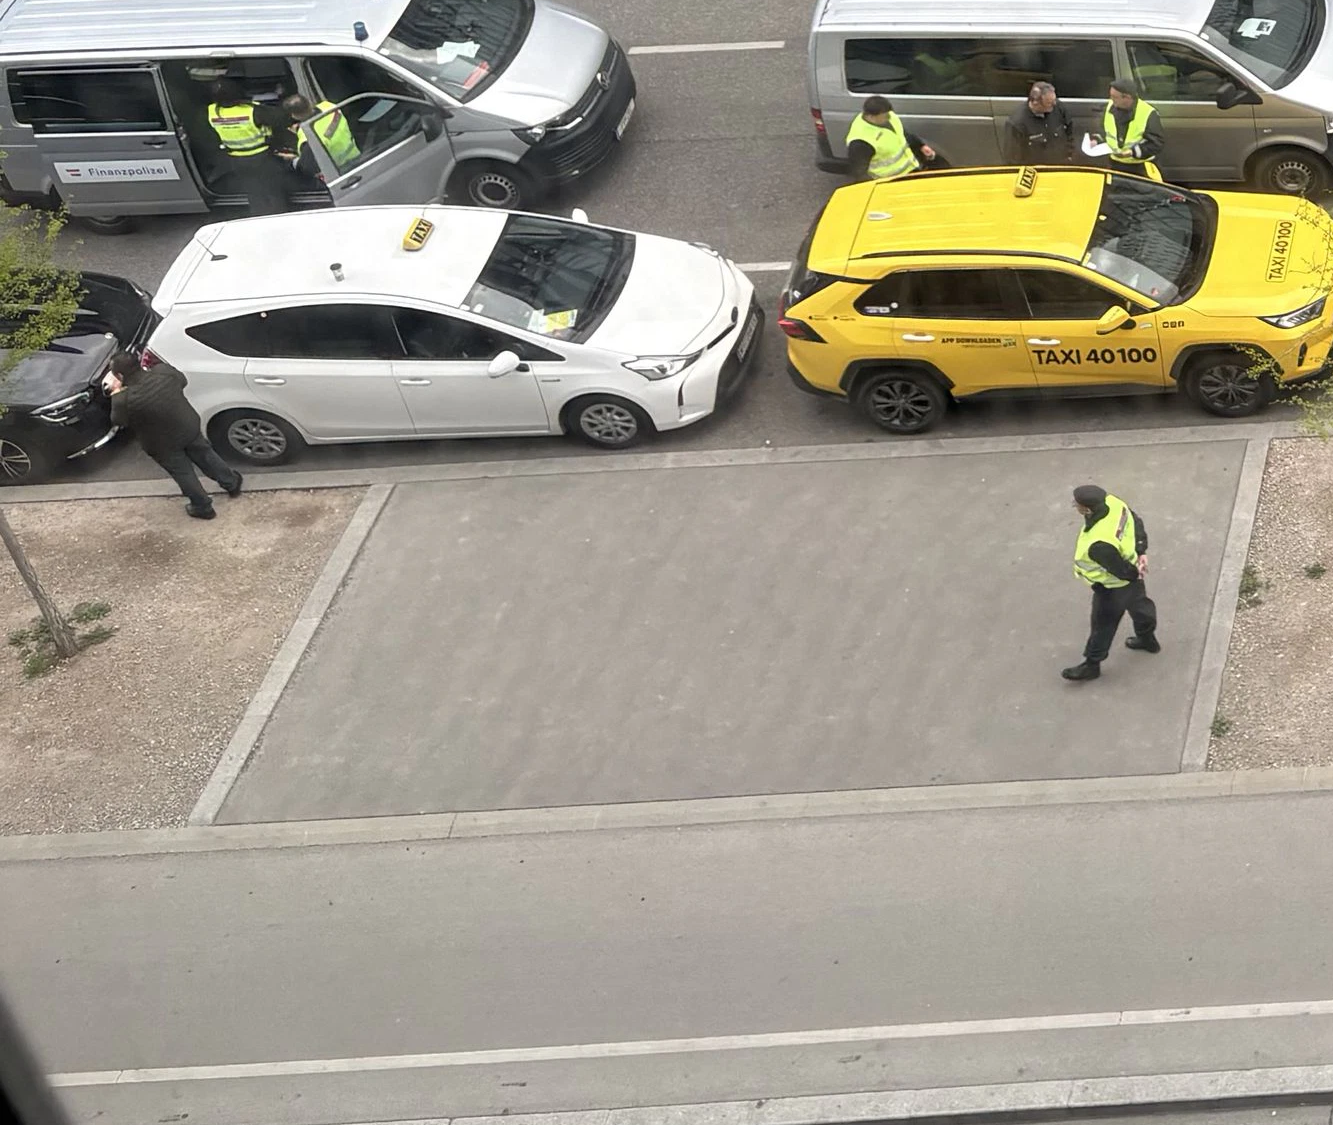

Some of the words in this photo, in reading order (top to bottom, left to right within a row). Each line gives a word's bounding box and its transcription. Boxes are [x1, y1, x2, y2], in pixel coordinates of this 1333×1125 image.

[88, 166, 168, 177] Finanzpolizei
[409, 218, 433, 244] TAXI
[1274, 221, 1293, 254] 40100
[1268, 256, 1287, 280] TAXI
[1032, 349, 1081, 365] TAXI
[1086, 348, 1157, 364] 40100
